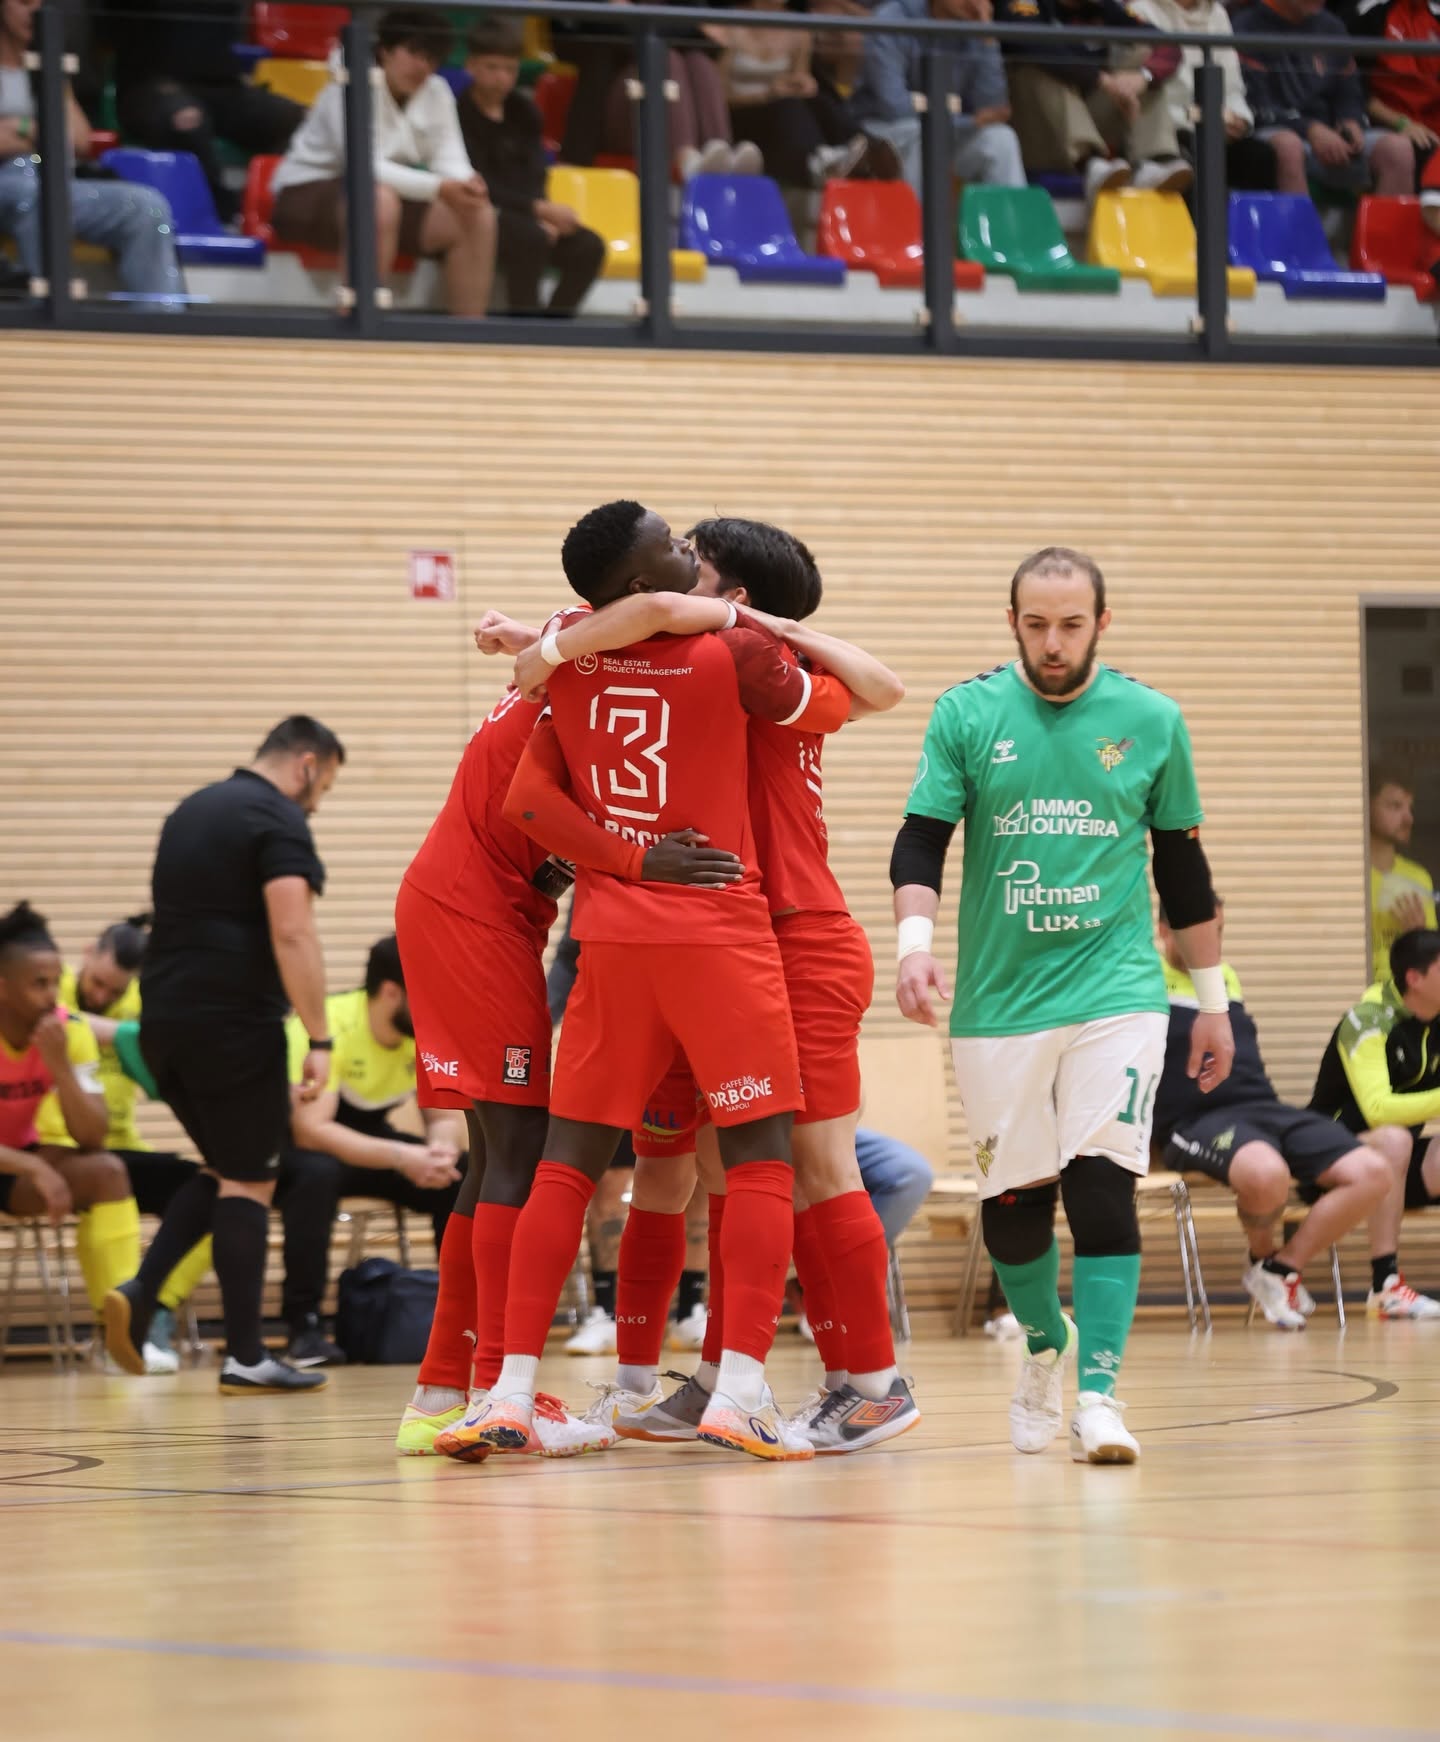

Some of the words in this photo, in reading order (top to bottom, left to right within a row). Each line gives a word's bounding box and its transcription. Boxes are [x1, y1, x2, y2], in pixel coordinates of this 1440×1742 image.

[603, 657, 621, 666] REAL
[623, 660, 651, 668] ESTATE
[603, 665, 635, 674] PROJECT
[636, 667, 693, 676] MANAGEMENT
[589, 686, 671, 822] 3
[1031, 799, 1093, 817] IMMO
[1030, 817, 1120, 837] OLIVEIRA
[1027, 910, 1080, 933] Lux
[706, 1077, 773, 1109] ORBONE
[726, 1101, 750, 1113] NAPOLI
